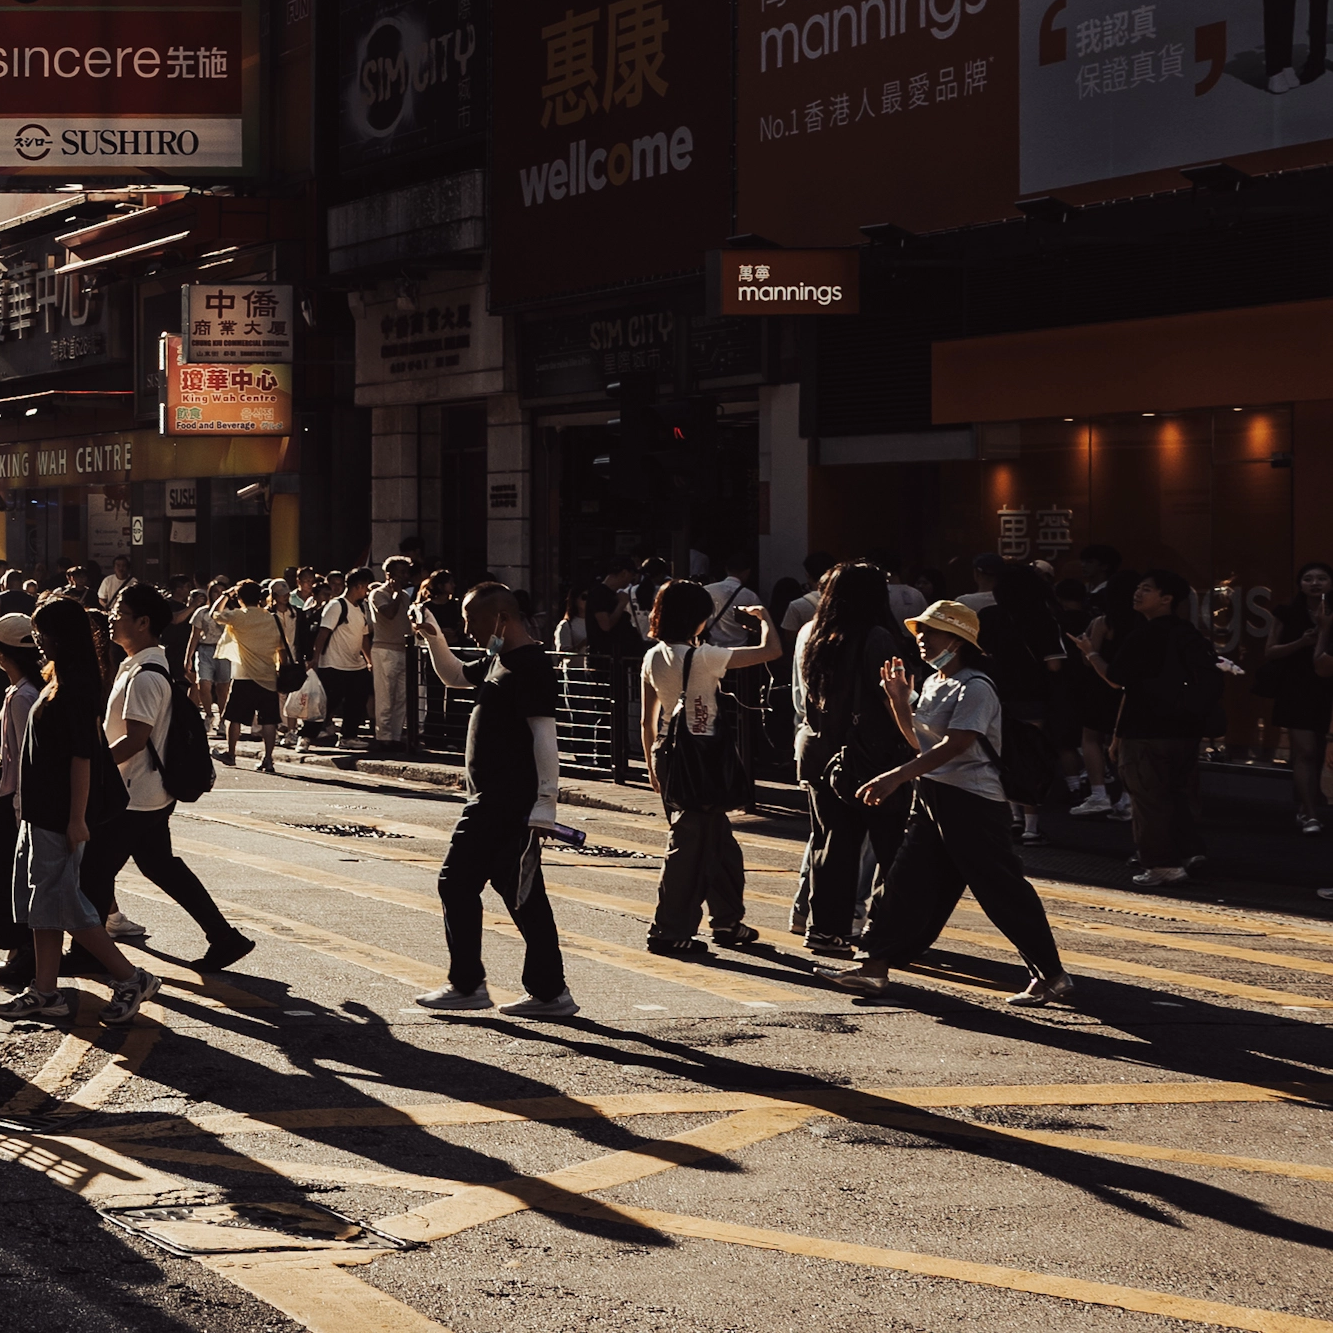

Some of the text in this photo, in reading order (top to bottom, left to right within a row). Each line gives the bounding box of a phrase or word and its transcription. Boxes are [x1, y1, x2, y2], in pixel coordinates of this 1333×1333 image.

[1075, 3, 1157, 58] 我認真
[166, 46, 228, 79] 先施
[362, 23, 476, 106] SIM CITY
[1075, 41, 1185, 100] 保證真貨
[61, 129, 198, 156] SUSHIRO
[759, 111, 800, 143] No.1
[519, 125, 694, 207] wellcome
[738, 264, 770, 282] 萬寧
[206, 289, 279, 319] 中僑
[737, 282, 842, 306] mannings
[193, 320, 287, 336] 商業大廈
[590, 310, 674, 351] SIM CITY
[180, 368, 279, 392] 瓊華中心
[176, 406, 202, 420] 飲食
[182, 394, 277, 404] King Wah Centre
[176, 421, 256, 430] Food and Beverage
[37, 448, 67, 476] WAH
[76, 442, 132, 473] CENTRE
[996, 503, 1073, 561] 萬寧
